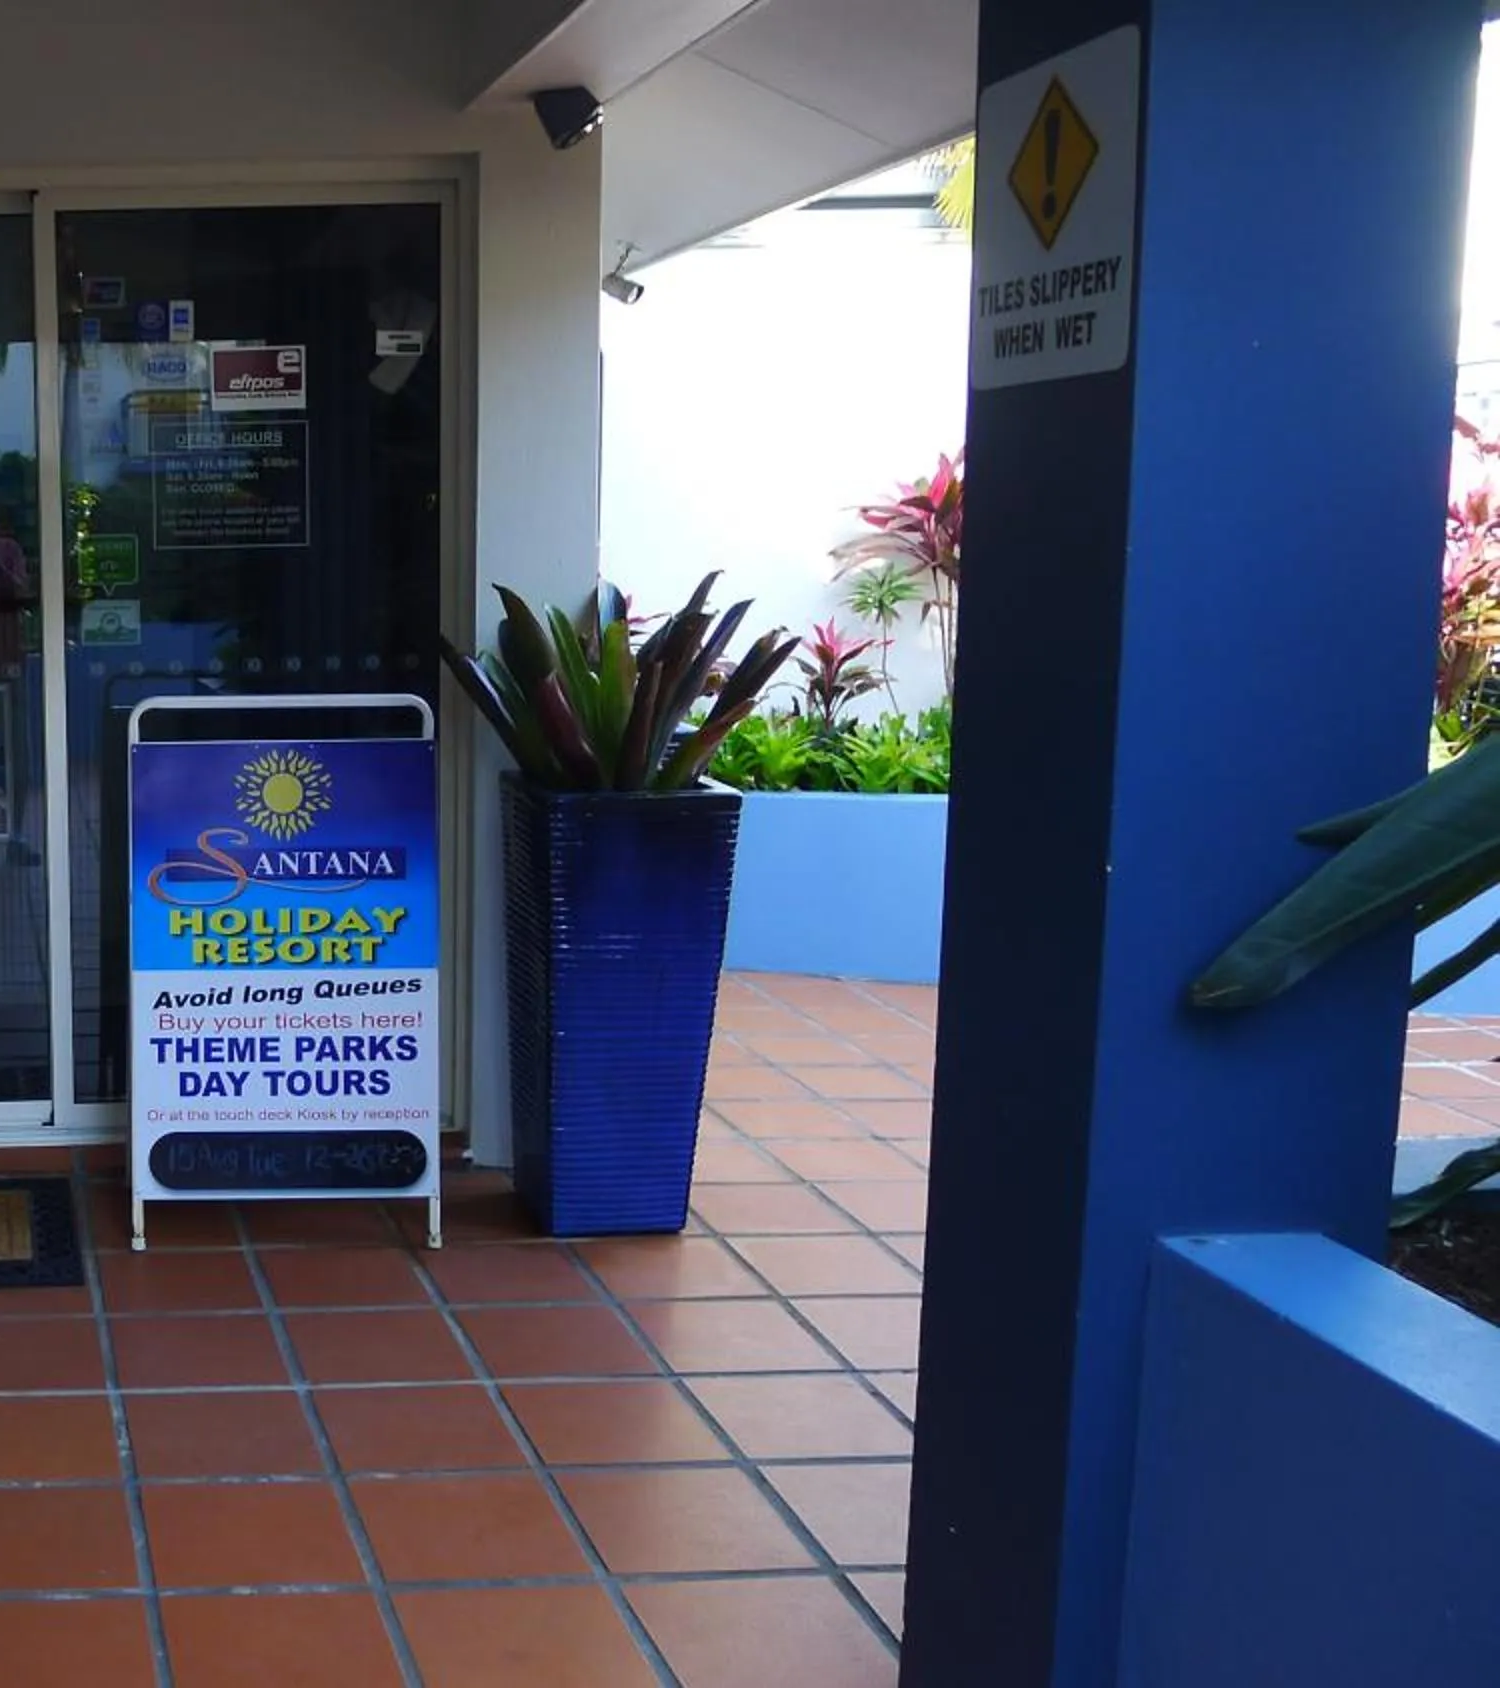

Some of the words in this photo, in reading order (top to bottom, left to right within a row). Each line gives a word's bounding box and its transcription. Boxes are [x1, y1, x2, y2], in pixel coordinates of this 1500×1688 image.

[978, 277, 1025, 318] TILES
[1029, 256, 1122, 307] SLIPPERY
[993, 321, 1044, 359] WHEN
[1055, 312, 1097, 350] WET
[229, 373, 286, 391] eftpos
[231, 430, 284, 446] HOURS
[168, 906, 407, 936] HOLIDAY
[191, 936, 384, 966] RESORT
[152, 986, 234, 1010] Avoid
[243, 984, 303, 1006] long
[313, 977, 422, 1000] Queues
[157, 1012, 205, 1035] Buy
[213, 1014, 264, 1033] your
[275, 1012, 353, 1030] tickets
[361, 1010, 422, 1029] here!
[150, 1036, 281, 1064] THEME
[294, 1034, 419, 1062] PARKS
[179, 1071, 250, 1098] DAY
[262, 1069, 391, 1097] TOURS
[147, 1109, 164, 1122] Or
[169, 1110, 184, 1122] at
[187, 1109, 210, 1122] the
[214, 1108, 254, 1122] touch
[259, 1109, 293, 1121] deck
[297, 1108, 337, 1121] Kiosk
[342, 1108, 358, 1122] by
[363, 1107, 430, 1122] reception
